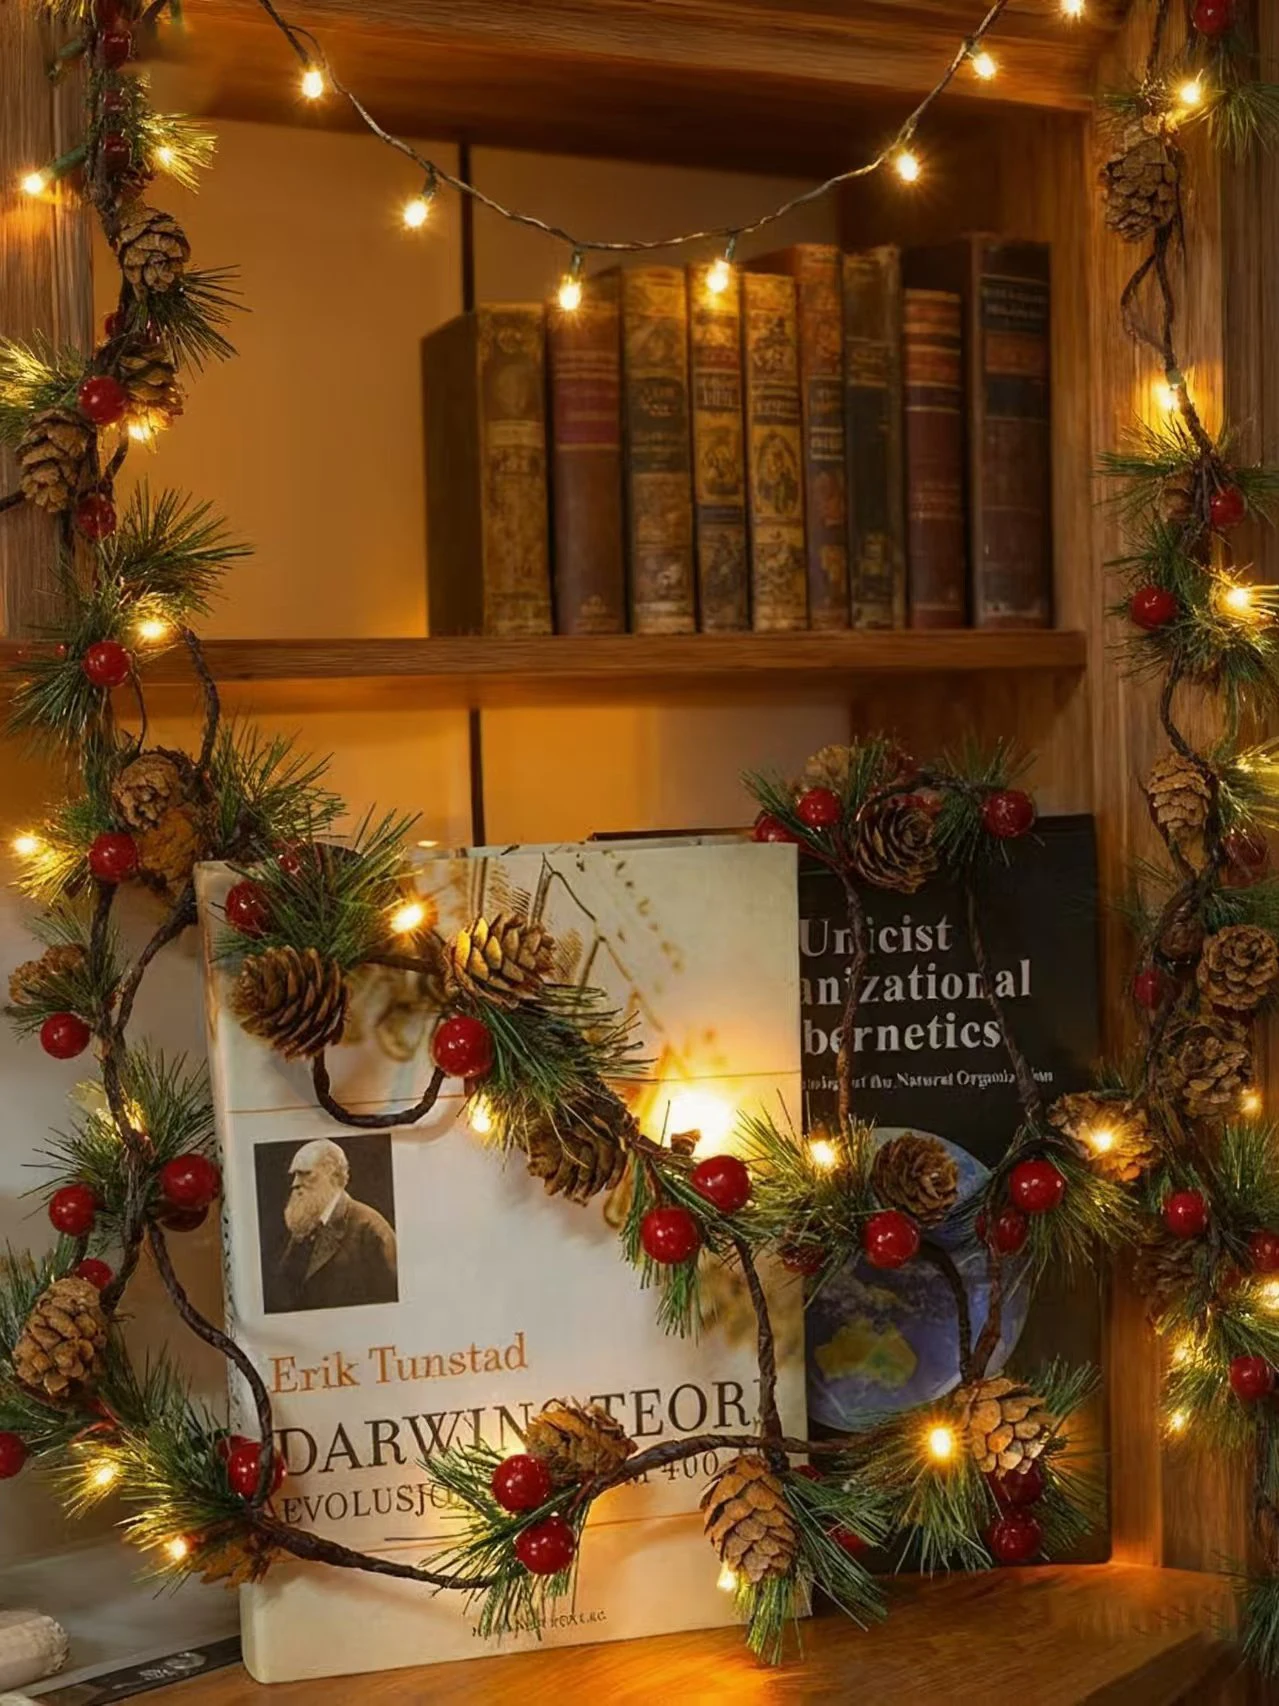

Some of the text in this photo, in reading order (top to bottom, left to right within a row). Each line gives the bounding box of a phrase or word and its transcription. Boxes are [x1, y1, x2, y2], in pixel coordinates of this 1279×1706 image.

[800, 914, 953, 957] Unicist
[803, 1012, 1004, 1056] bernetics
[957, 1067, 1054, 1090] Organizion
[267, 1331, 529, 1394] Erik Tunstad
[275, 1379, 762, 1477] DARWIN TEOR
[284, 1482, 462, 1524] EVOLUSJO
